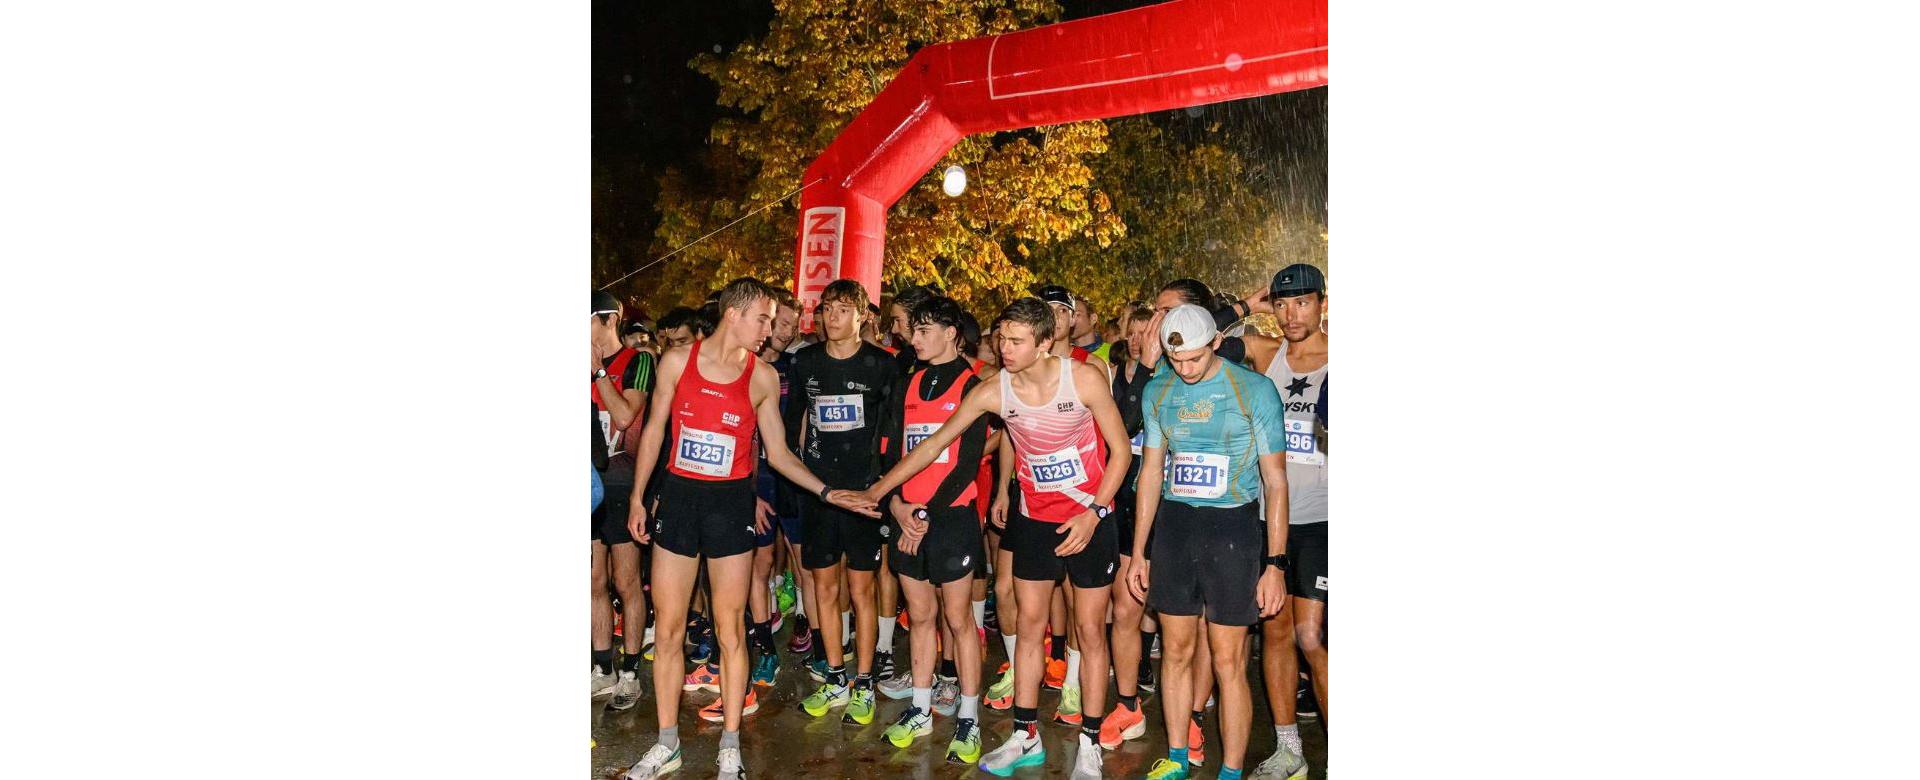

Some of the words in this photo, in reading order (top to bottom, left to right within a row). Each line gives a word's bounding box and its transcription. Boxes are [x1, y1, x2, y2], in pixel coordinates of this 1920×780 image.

[825, 406, 848, 420] 451
[1057, 402, 1074, 410] CHP
[723, 412, 740, 424] CHP
[684, 441, 722, 463] 1325
[1035, 462, 1073, 480] 1326
[1176, 466, 1212, 484] 1321
